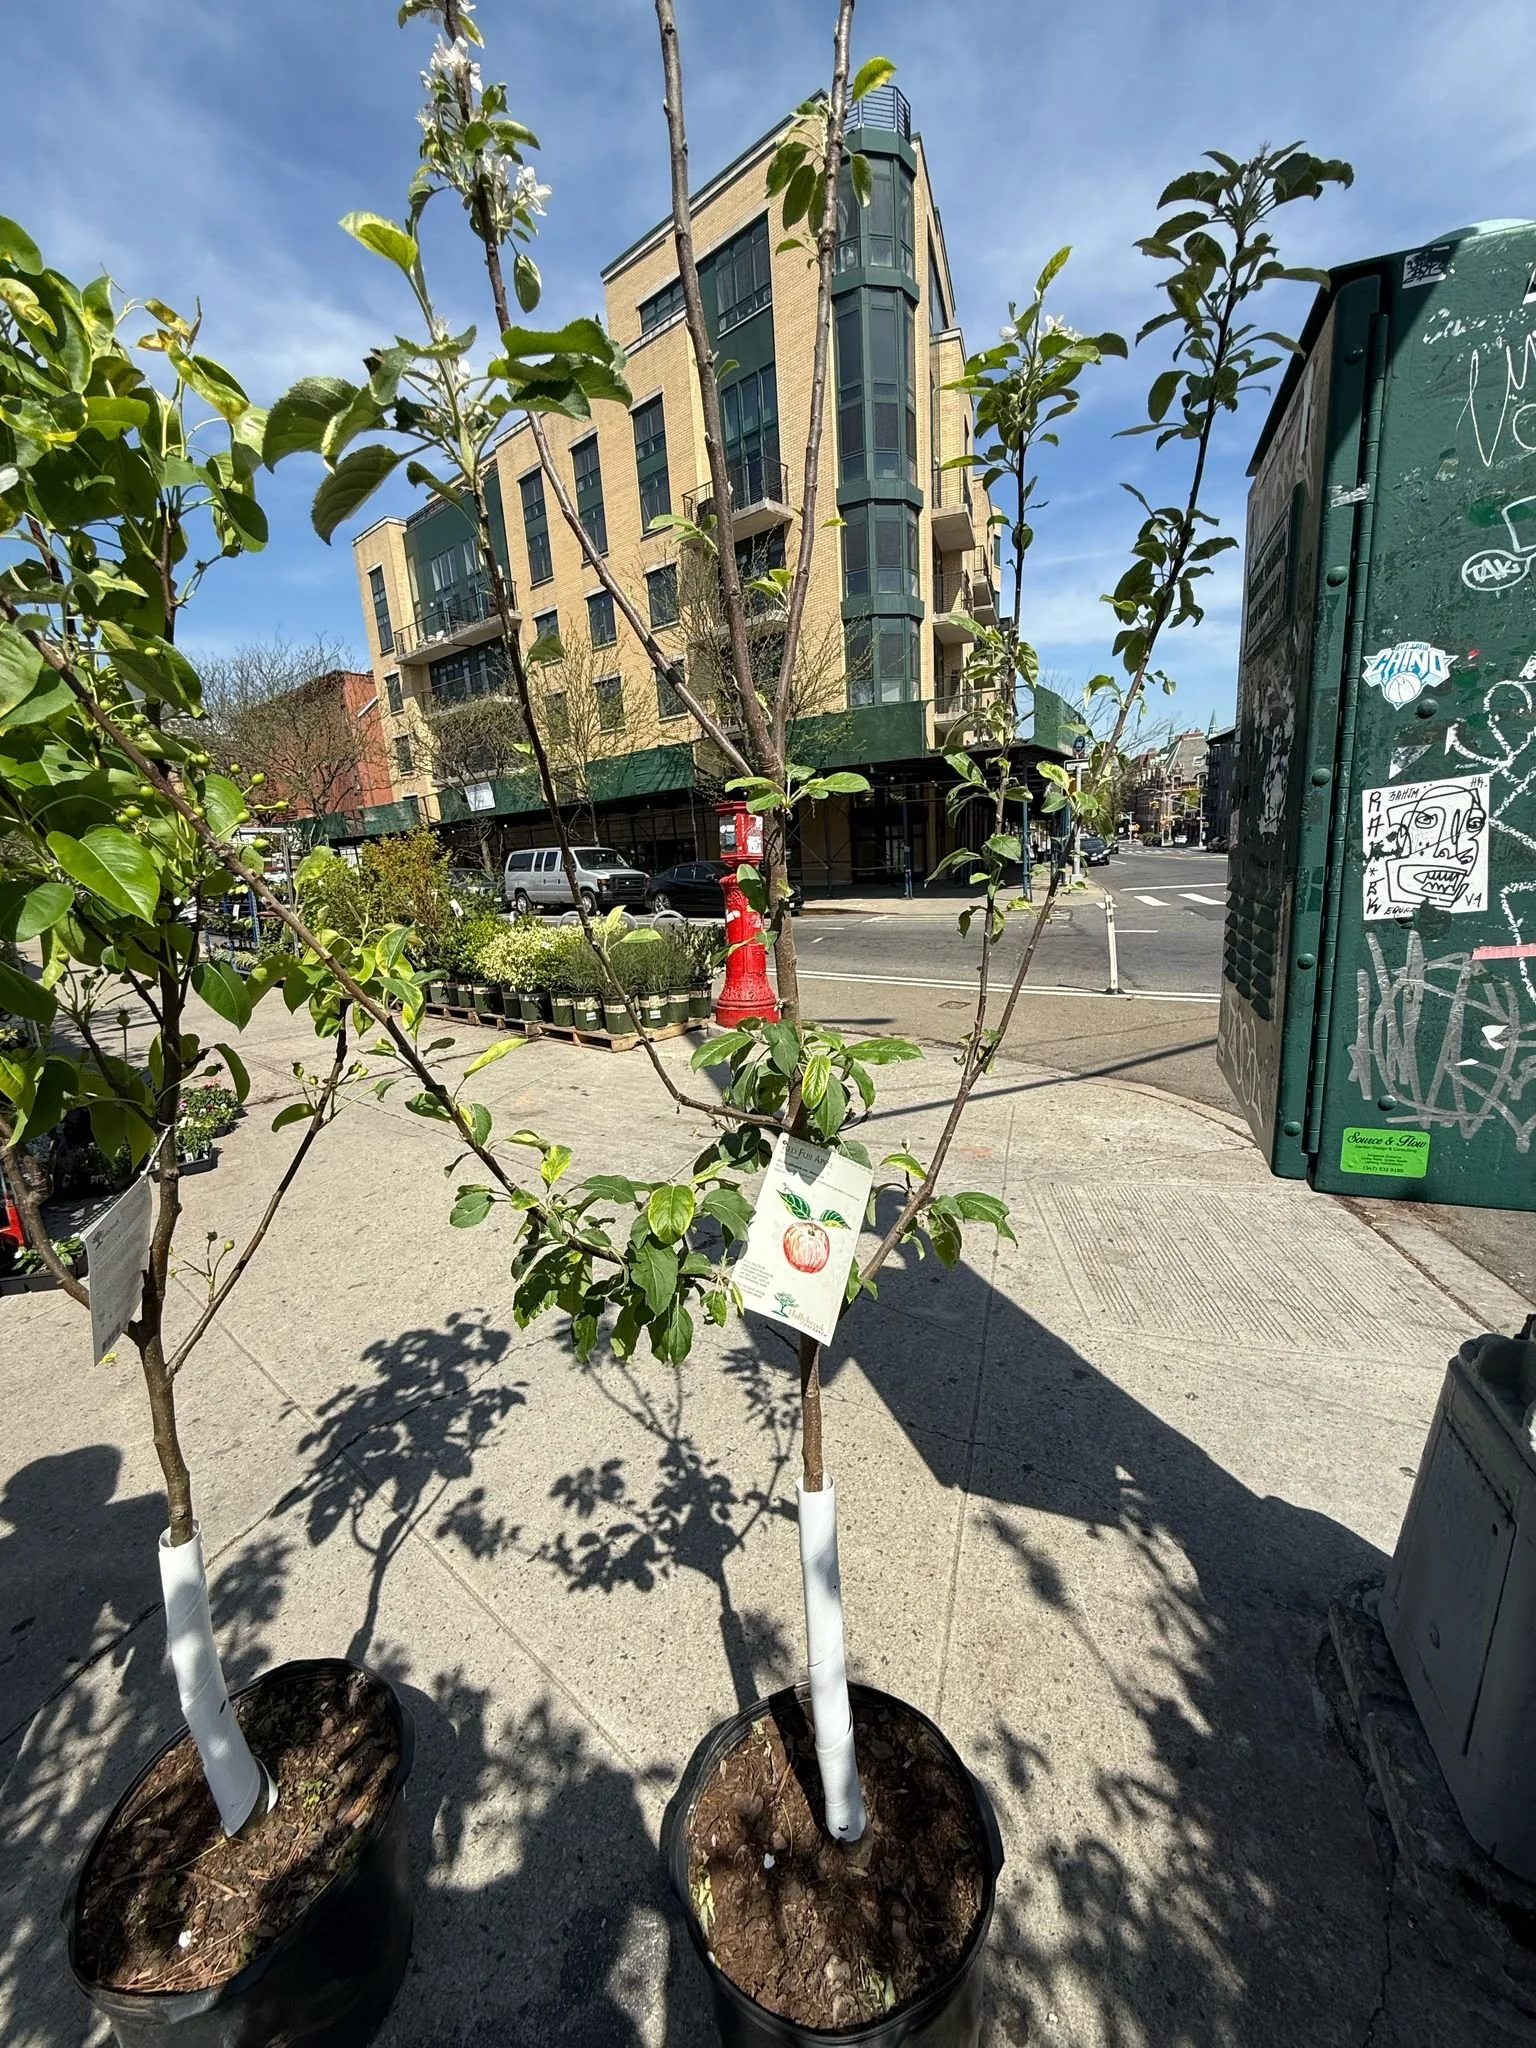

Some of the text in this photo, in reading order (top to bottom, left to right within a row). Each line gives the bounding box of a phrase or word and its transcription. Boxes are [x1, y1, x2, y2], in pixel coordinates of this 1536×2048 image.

[1367, 649, 1446, 679] CHINO
[1347, 1131, 1427, 1149] Source & Flow
[798, 1147, 813, 1161] FUJI
